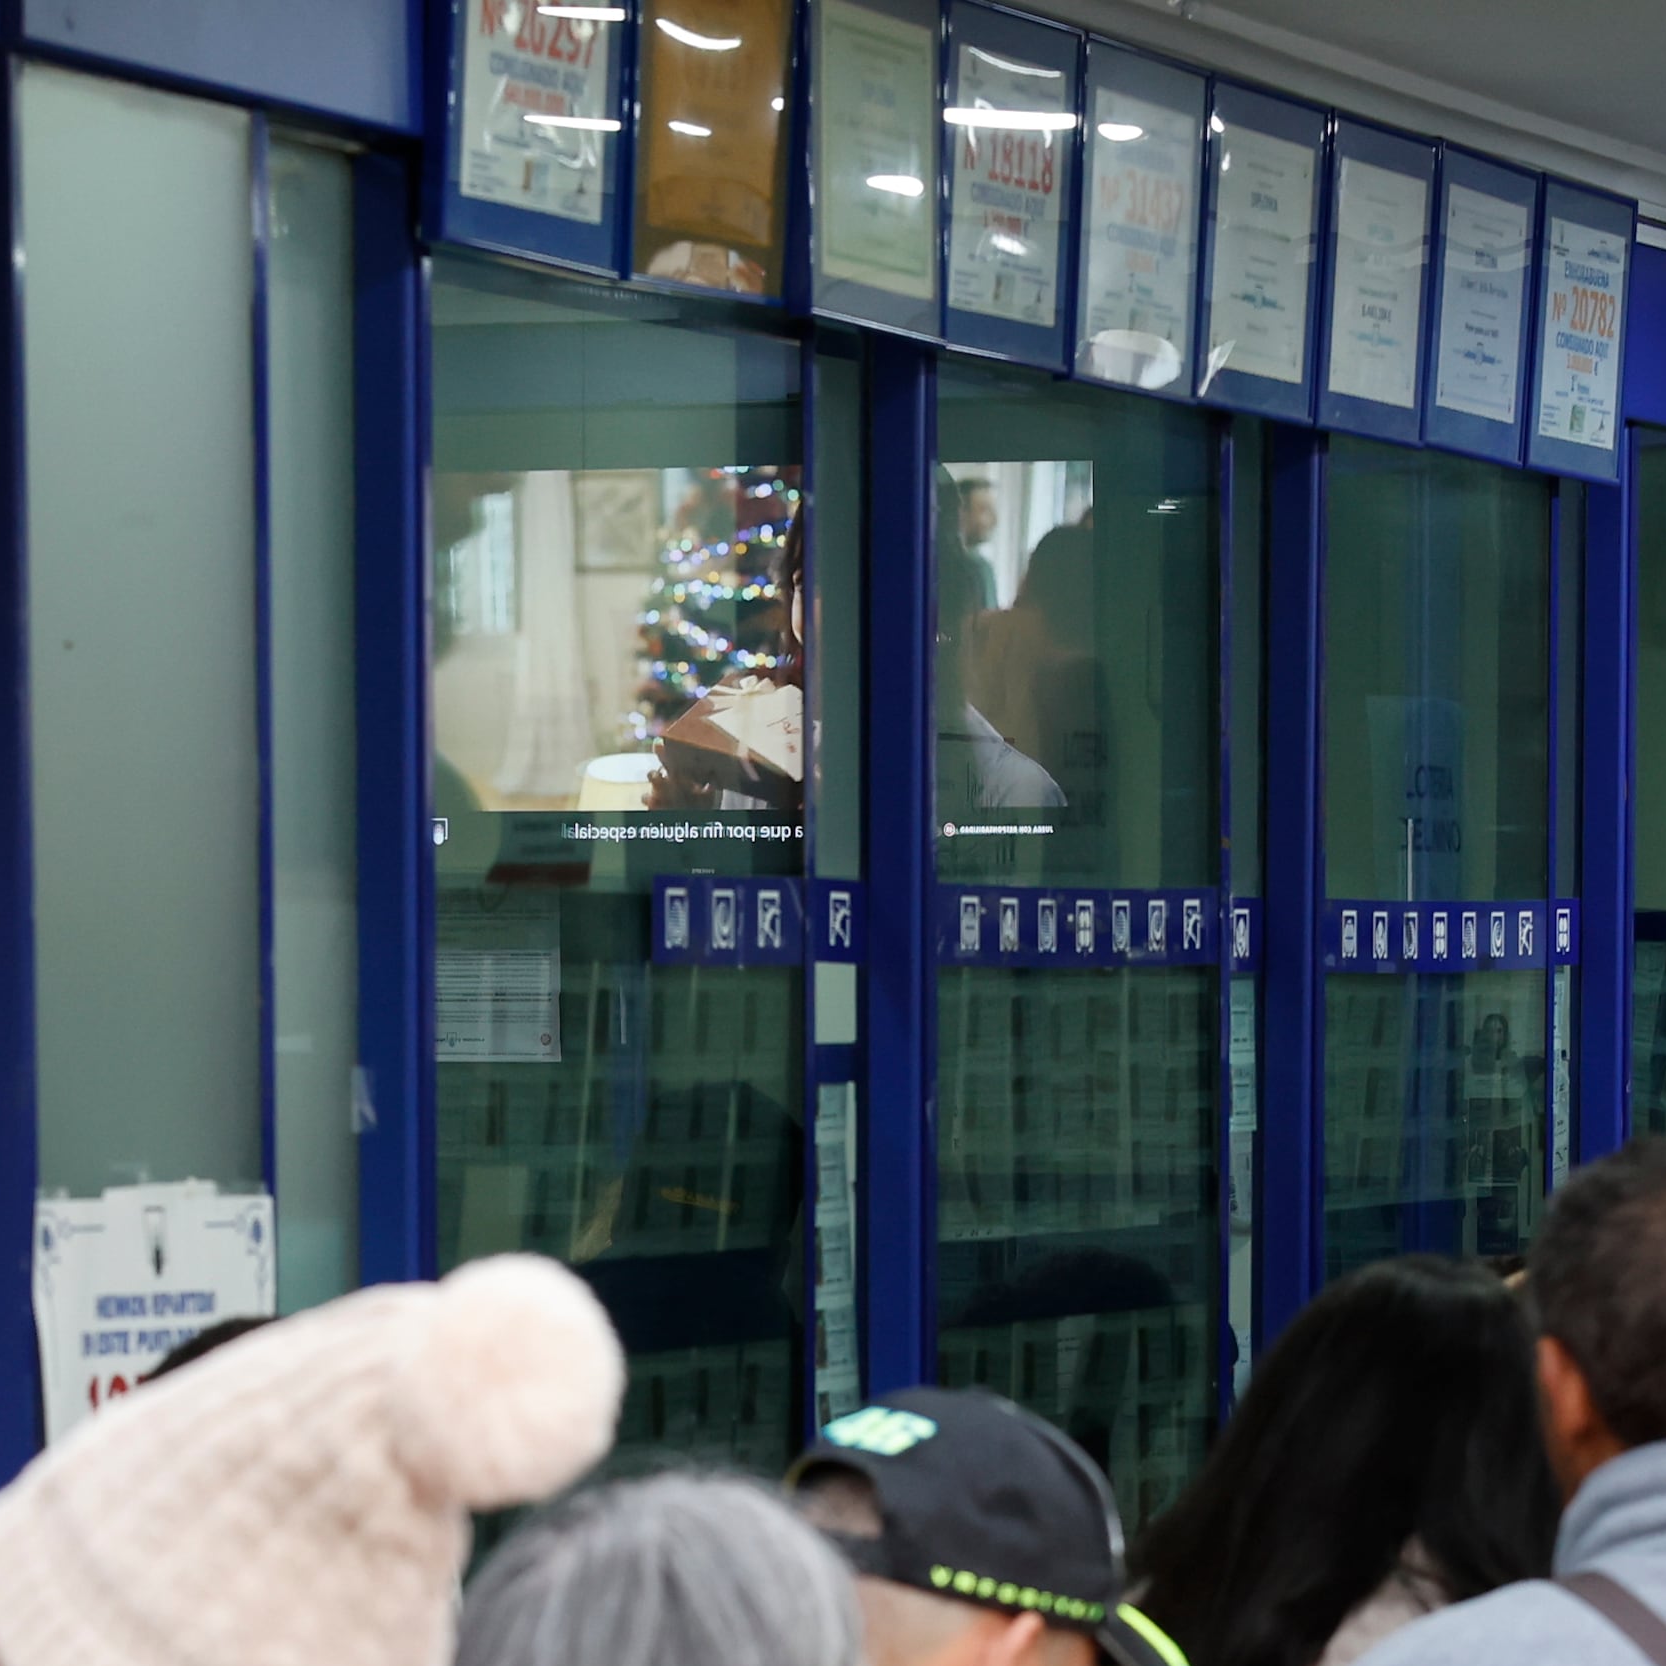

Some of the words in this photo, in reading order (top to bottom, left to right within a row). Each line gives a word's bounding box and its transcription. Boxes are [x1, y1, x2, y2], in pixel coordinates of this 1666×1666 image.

[987, 131, 1055, 194] 18118
[1564, 260, 1610, 289] ENHORABUENA
[1570, 286, 1617, 338] 20782
